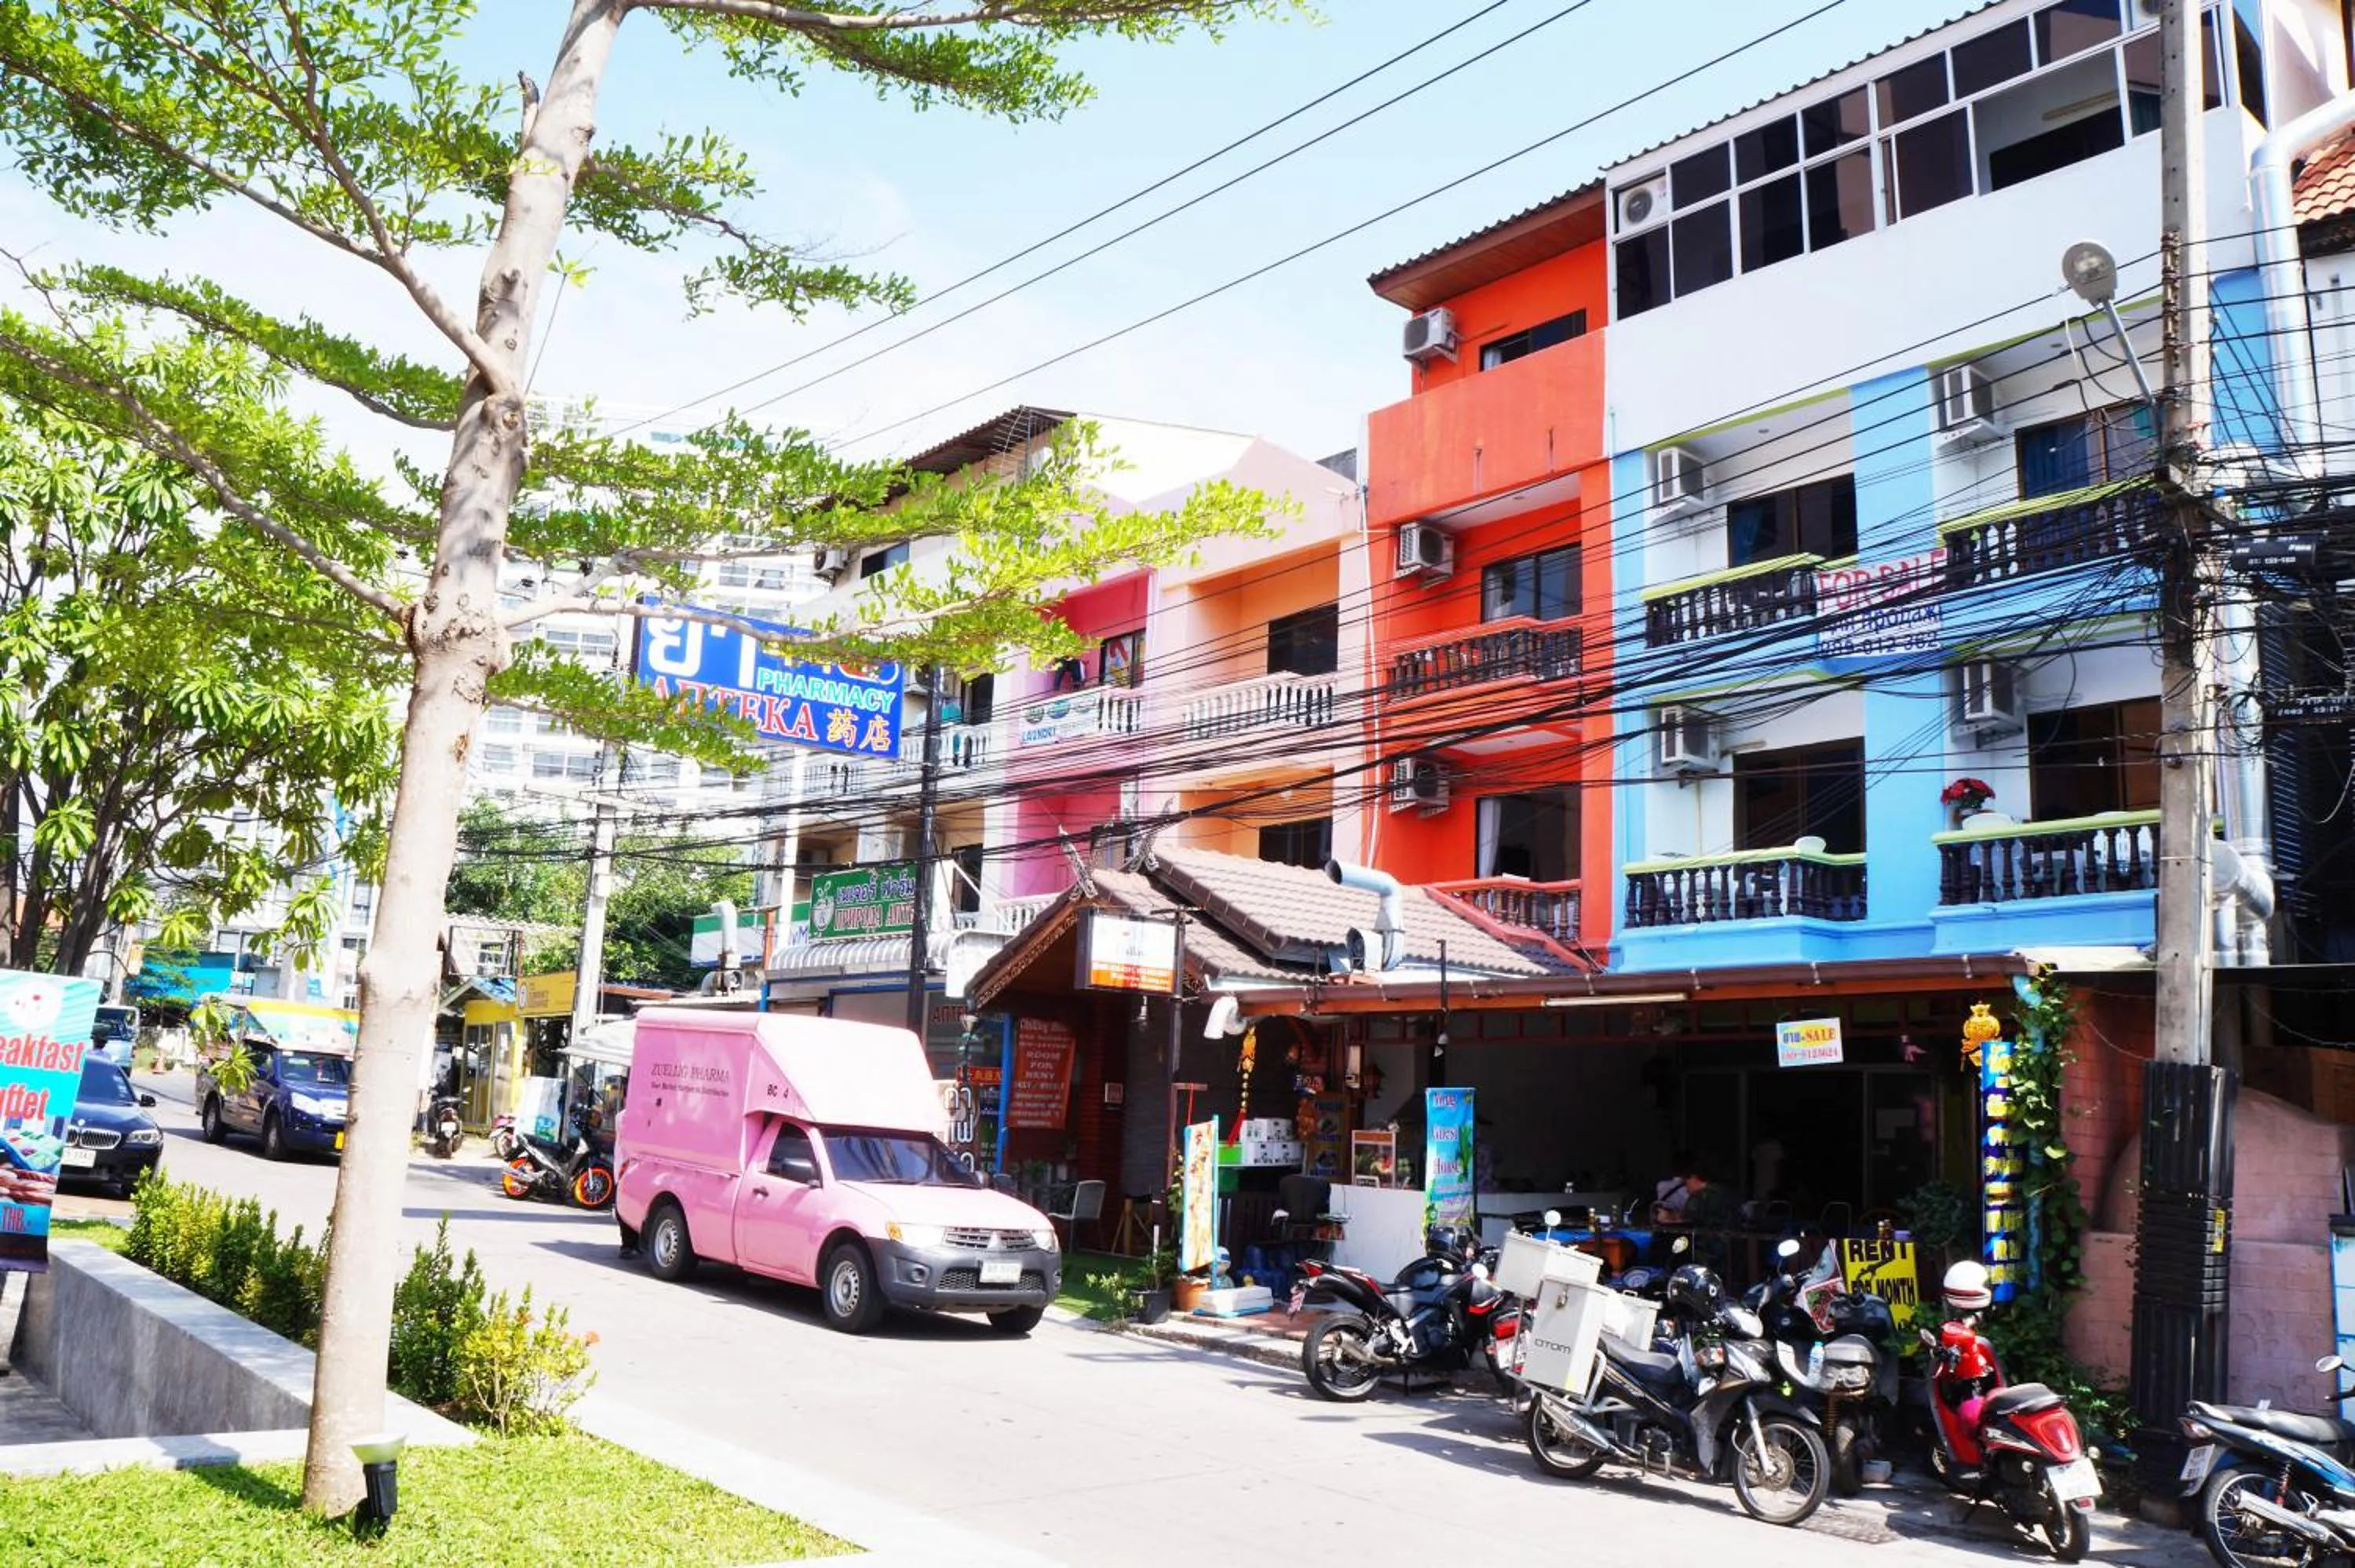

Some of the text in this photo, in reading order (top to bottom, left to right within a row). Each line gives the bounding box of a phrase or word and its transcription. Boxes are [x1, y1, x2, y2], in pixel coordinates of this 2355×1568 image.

[1816, 569, 1873, 612] FOR
[756, 666, 896, 715] PHARMACY
[826, 707, 893, 752] 药店
[691, 1067, 730, 1084] PHARMA
[1848, 1239, 1908, 1263] RENT
[1876, 1275, 1915, 1307] MONTH
